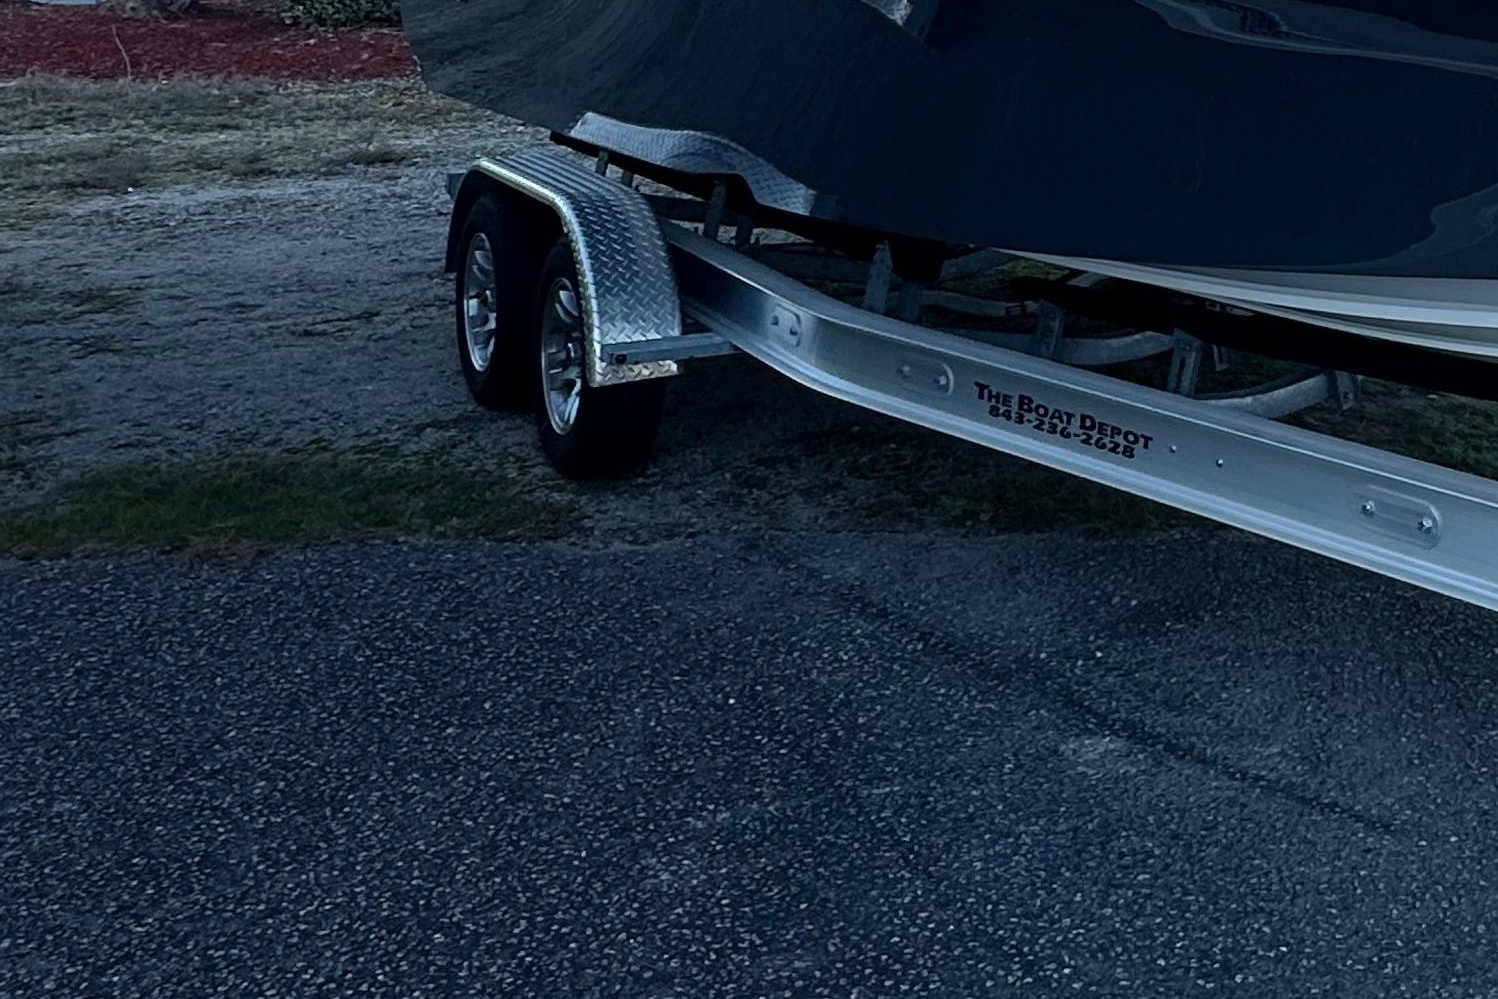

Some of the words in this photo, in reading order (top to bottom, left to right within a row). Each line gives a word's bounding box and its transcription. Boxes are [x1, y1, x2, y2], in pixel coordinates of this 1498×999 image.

[974, 381, 1012, 408] THE
[1017, 394, 1075, 427] BOAT
[1079, 413, 1153, 450] DEPOT
[988, 405, 1135, 459] 843-236-2628
